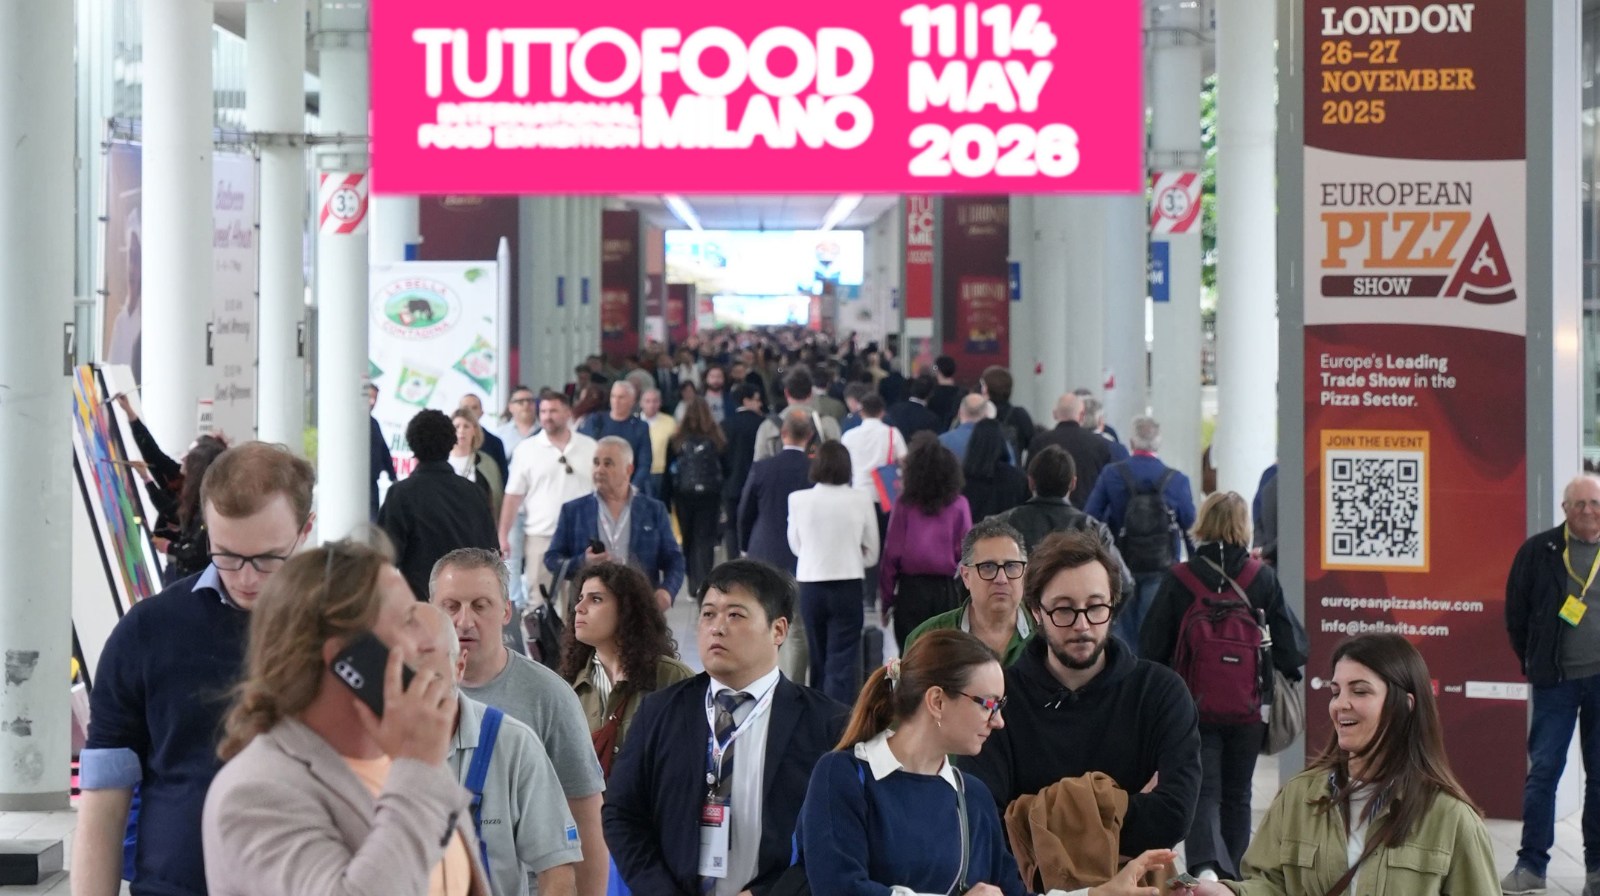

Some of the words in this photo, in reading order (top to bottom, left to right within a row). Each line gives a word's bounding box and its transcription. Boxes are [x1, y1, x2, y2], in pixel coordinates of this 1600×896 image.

[1321, 4, 1475, 35] LONDON
[908, 60, 1054, 113] MAY
[1321, 68, 1476, 92] NOVEMBER
[641, 94, 874, 149] MILANO
[1321, 100, 1386, 124] 2025
[908, 123, 1080, 177] 2026
[1321, 182, 1472, 206] EUROPEAN
[1320, 212, 1515, 302] PIZZA
[1353, 277, 1412, 296] SHOW
[1320, 353, 1383, 372] Europe's
[1386, 354, 1449, 373] Leading
[1320, 372, 1366, 388] Trade
[1369, 373, 1411, 388] Show
[1414, 373, 1428, 388] in
[1431, 373, 1457, 389] the
[1320, 391, 1360, 406] Pizza
[1363, 392, 1418, 407] Sector.
[1326, 436, 1355, 447] JOIN
[1358, 436, 1381, 447] THE
[1384, 437, 1424, 448] EVENT
[1321, 596, 1484, 612] europeanpizzashow.com
[1321, 619, 1450, 636] info@bellavita.com
